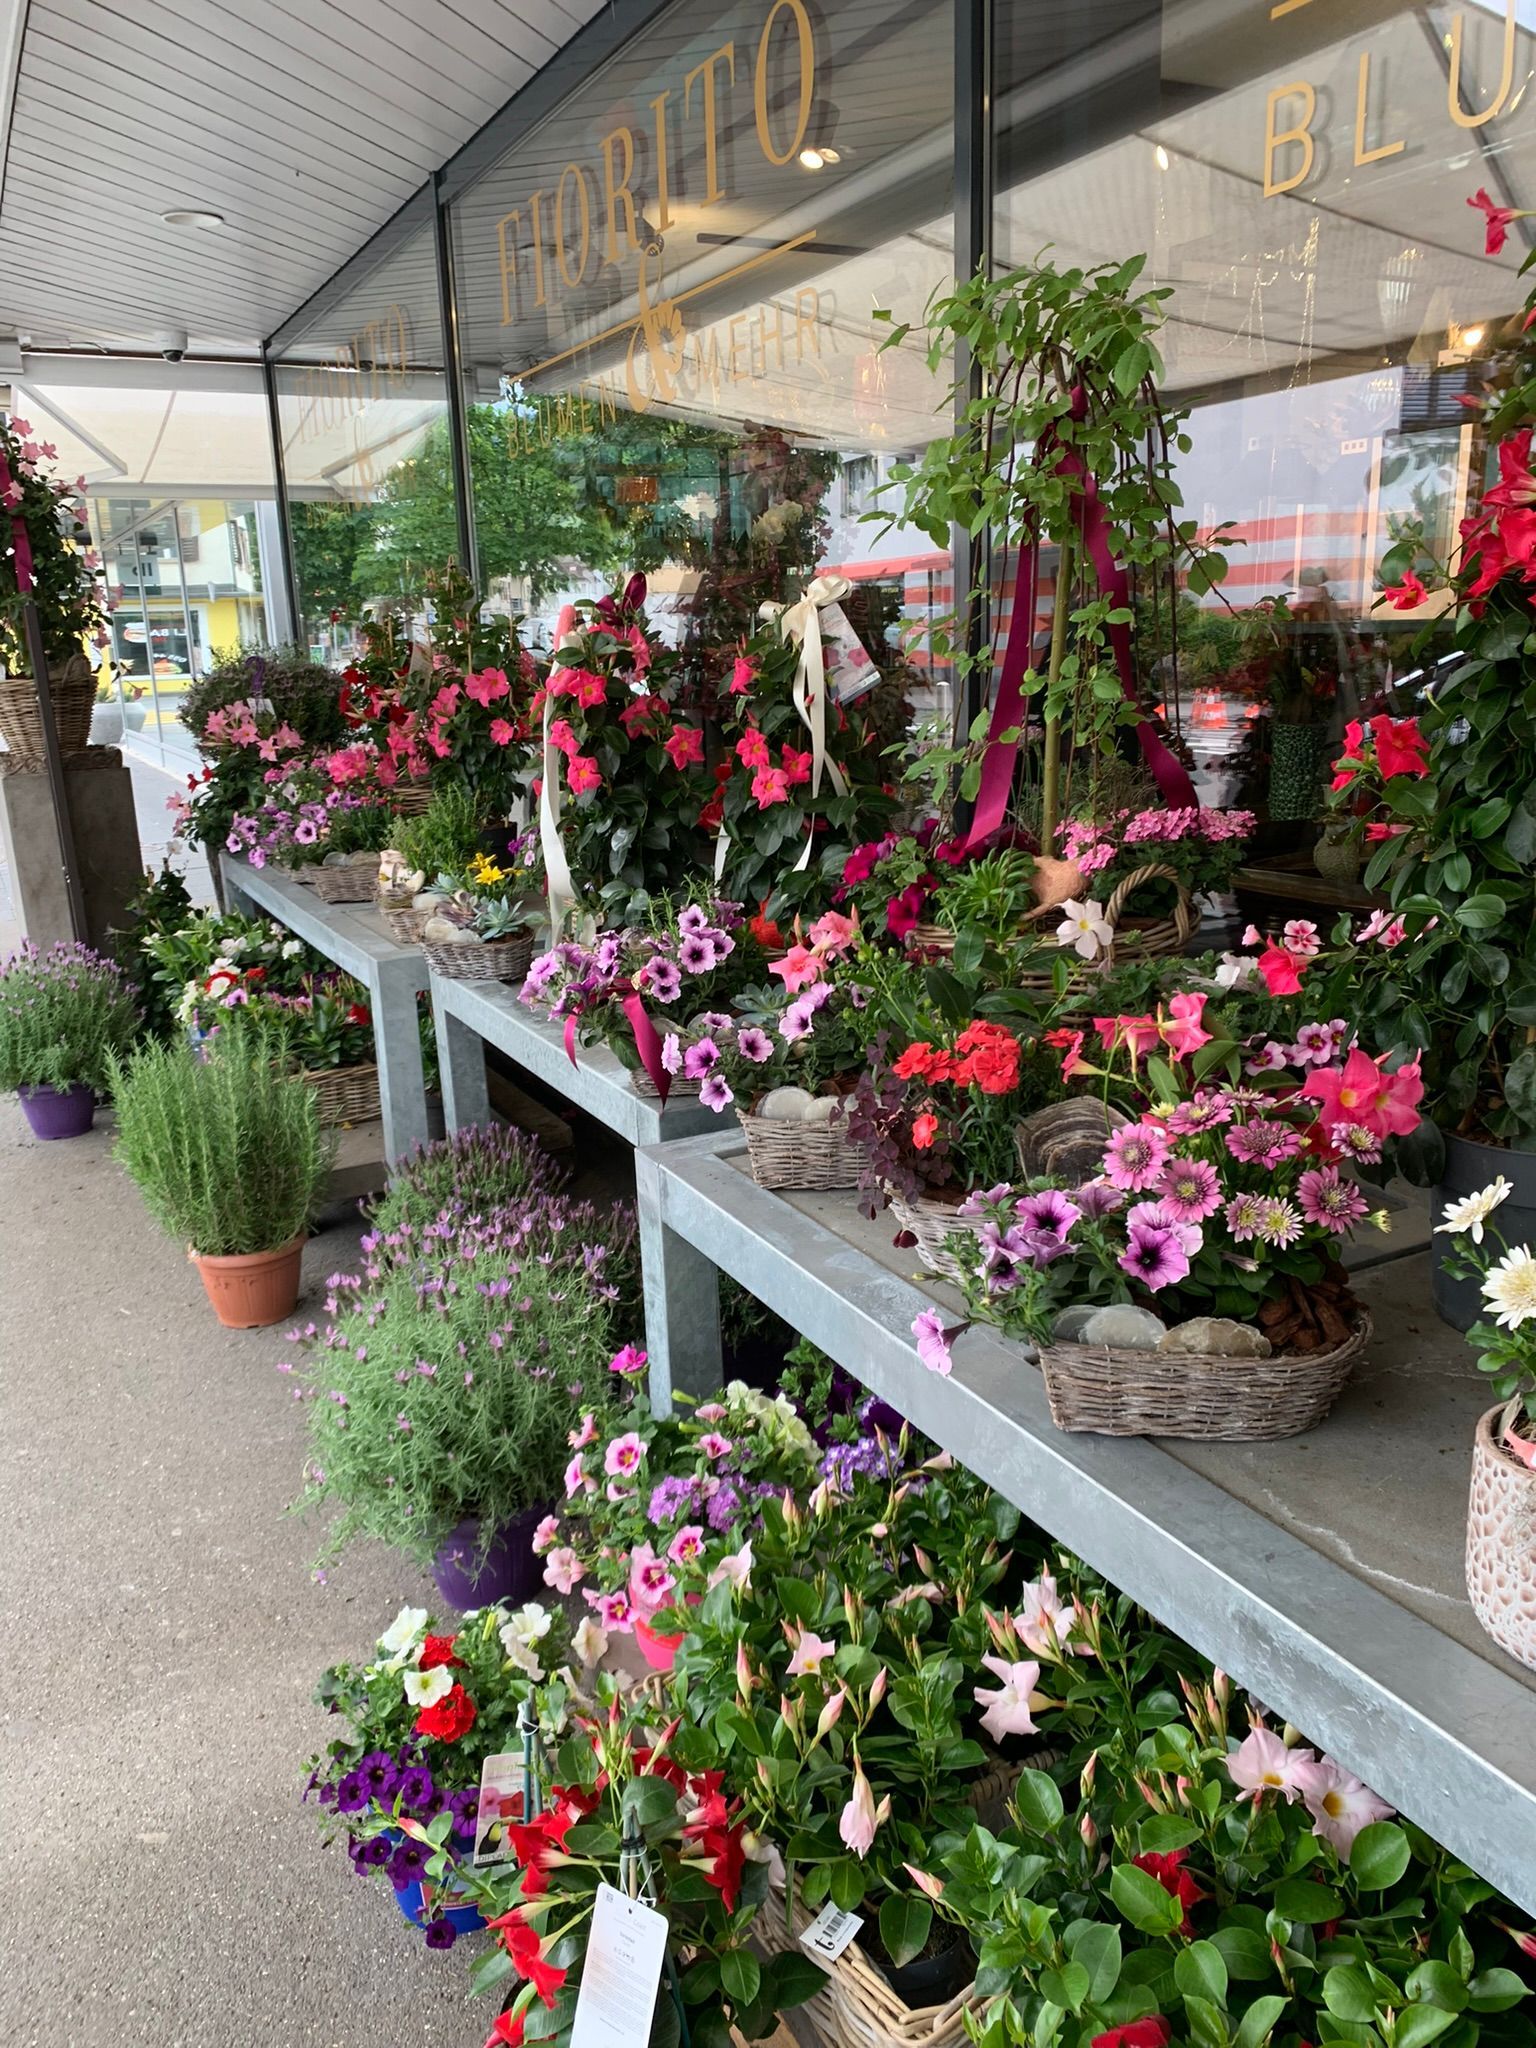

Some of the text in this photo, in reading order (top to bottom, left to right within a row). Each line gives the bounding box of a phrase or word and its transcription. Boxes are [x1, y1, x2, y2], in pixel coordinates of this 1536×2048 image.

[495, 0, 815, 327] FIORITO
[507, 370, 617, 459] BLUMEN
[694, 287, 820, 391] MEHR
